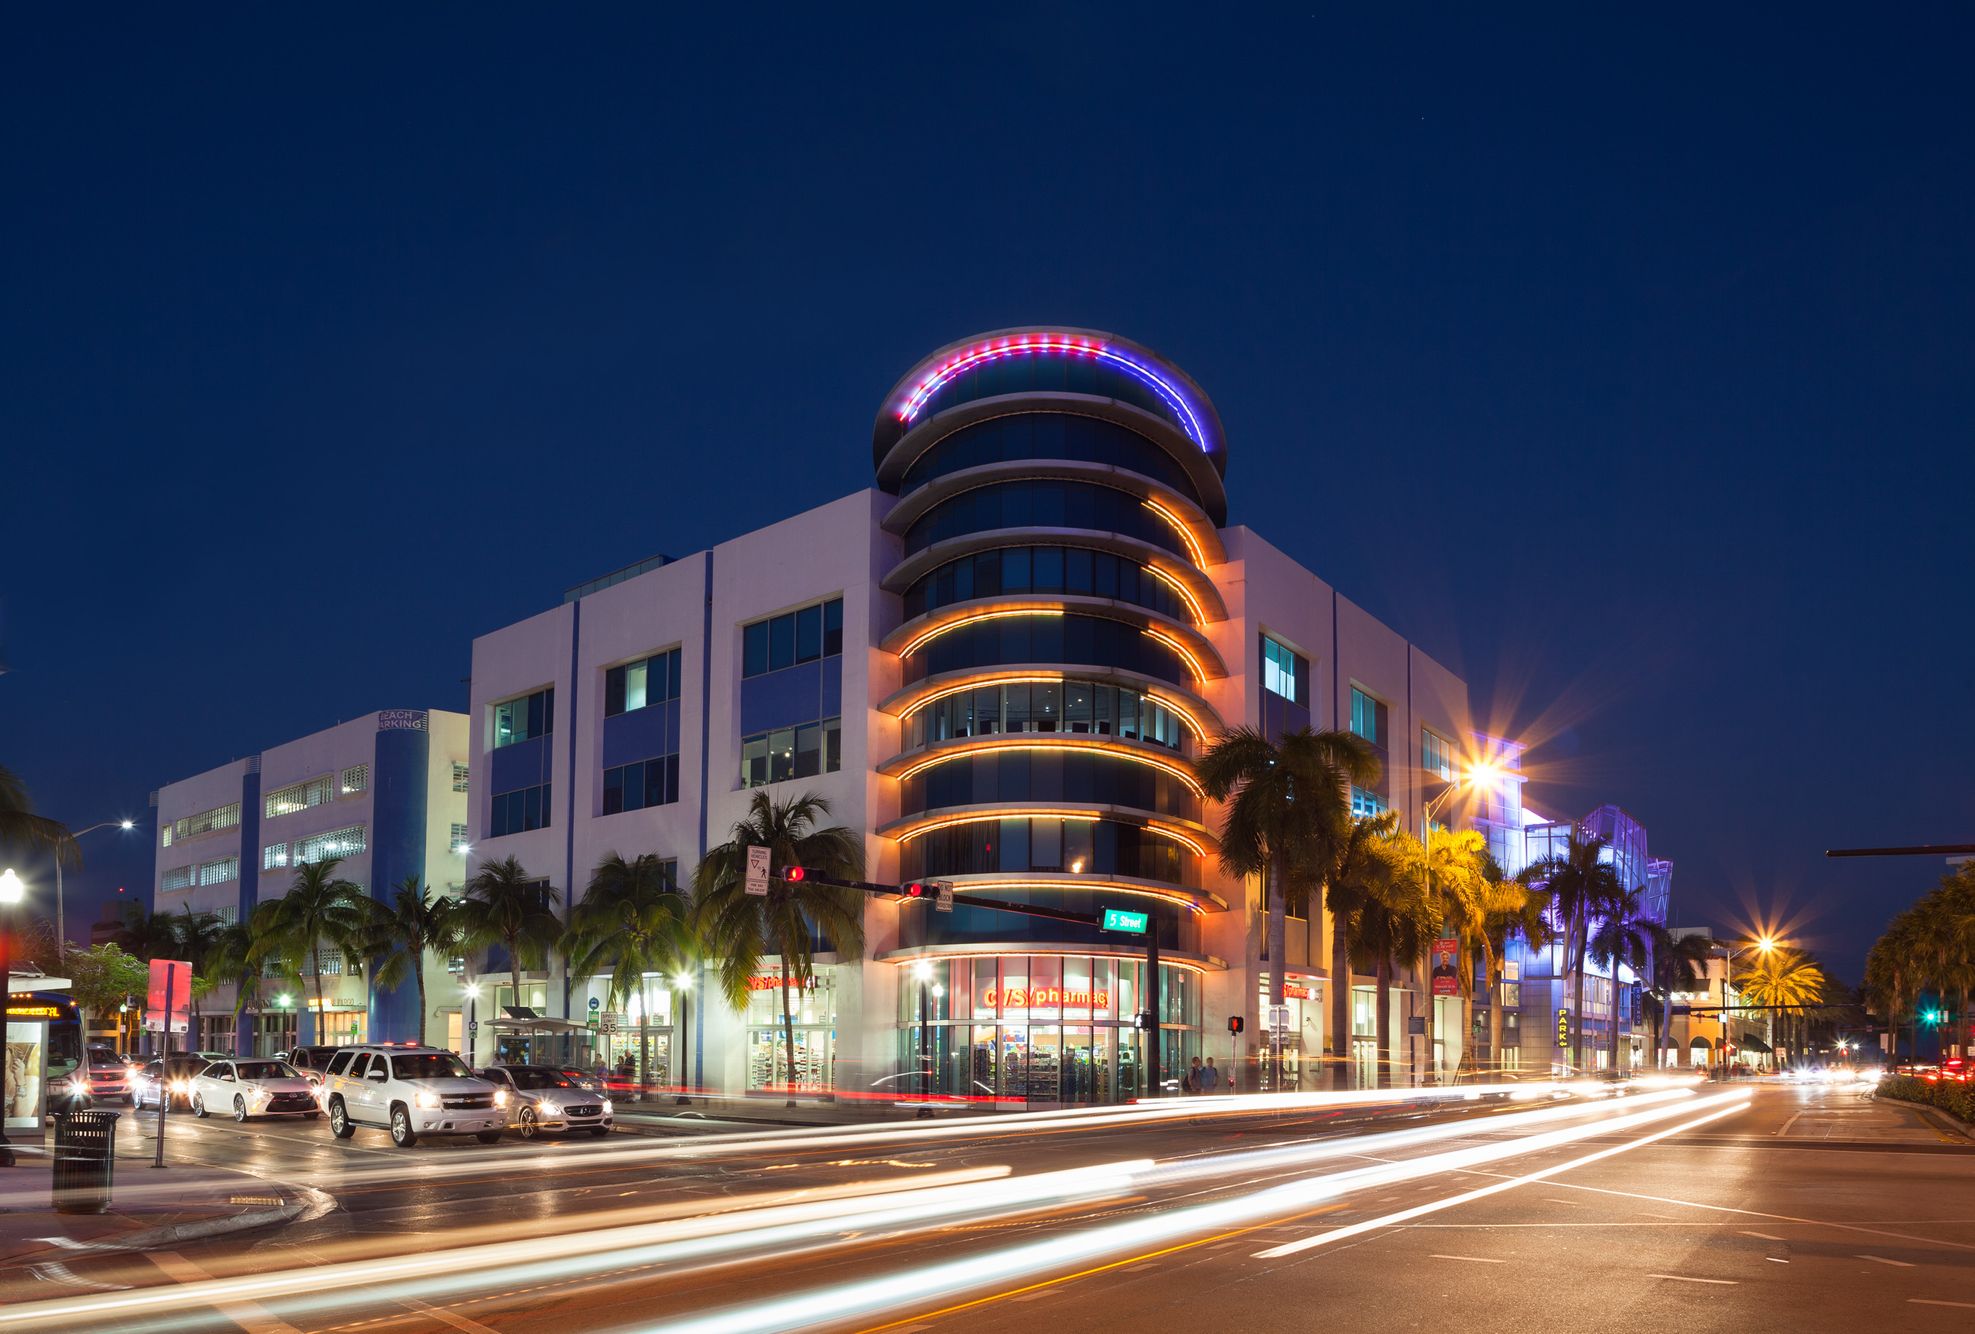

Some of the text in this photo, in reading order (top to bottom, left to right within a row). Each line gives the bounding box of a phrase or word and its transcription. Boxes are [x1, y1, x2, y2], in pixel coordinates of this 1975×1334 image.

[1110, 913, 1141, 928] 5 Street
[602, 1023, 617, 1033] 35
[1558, 1009, 1567, 1040] PARK
